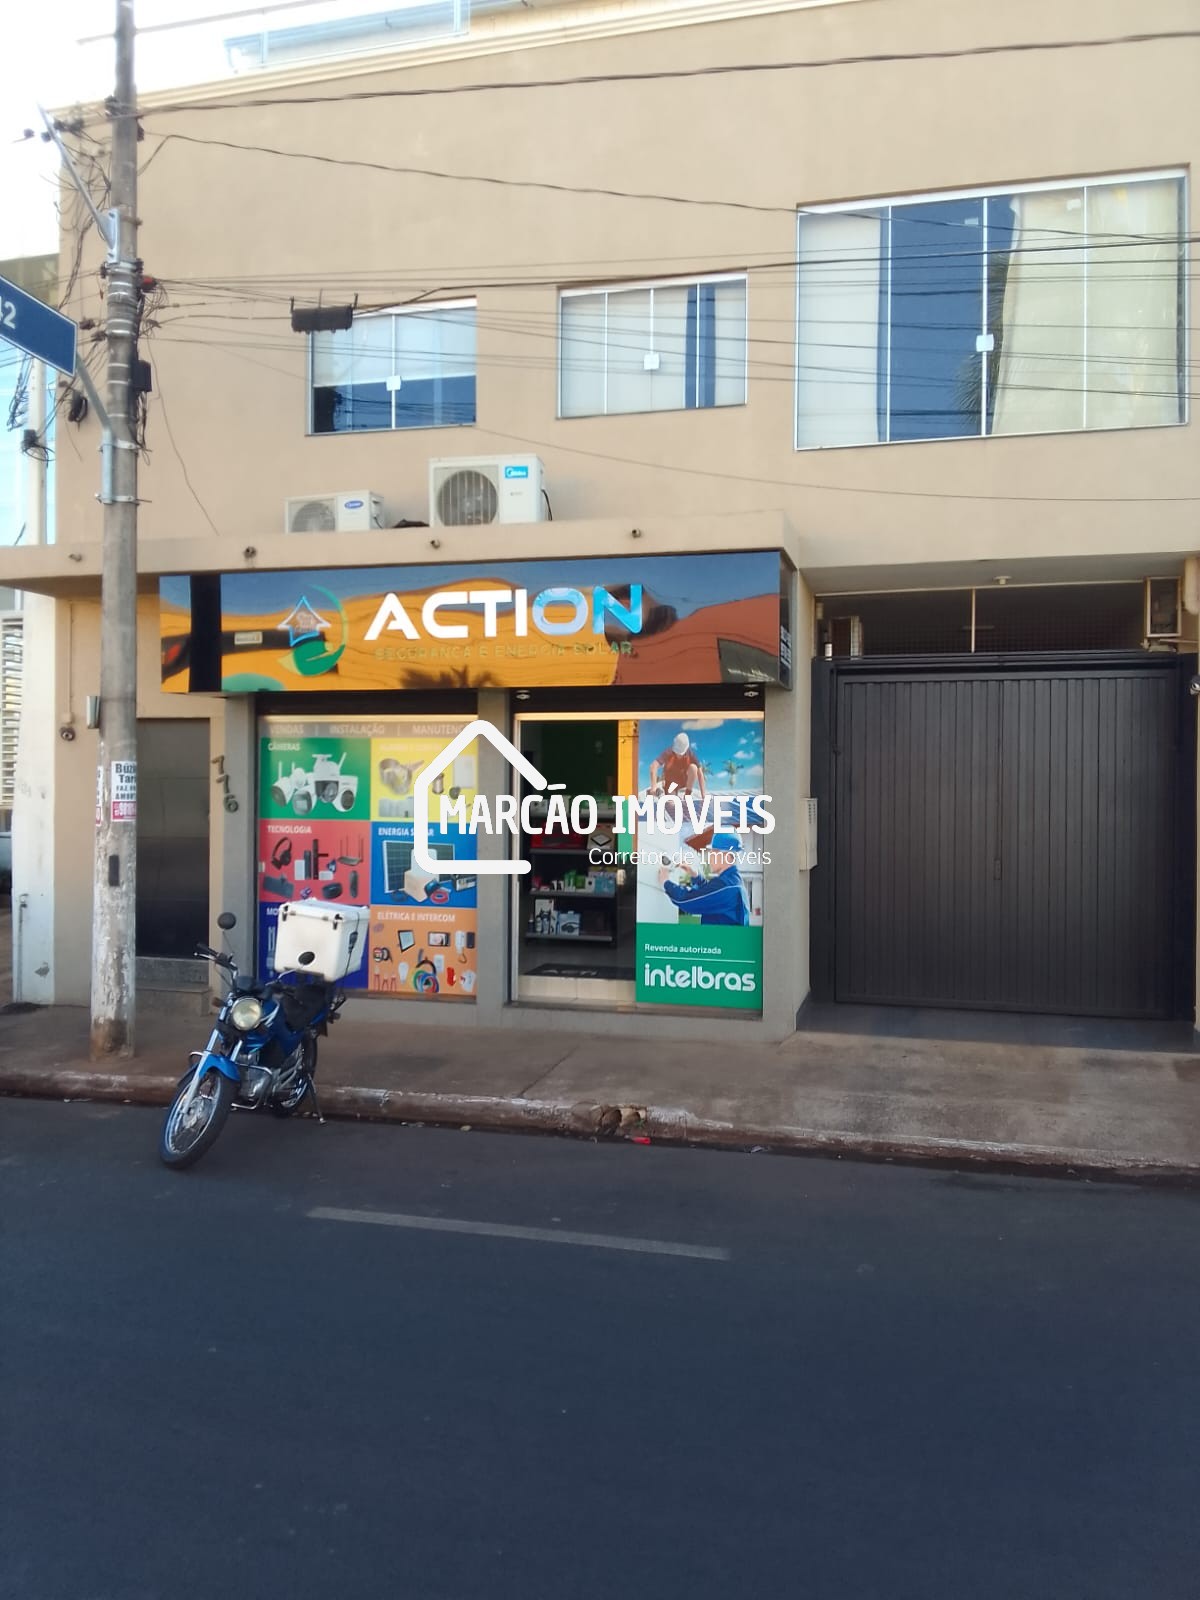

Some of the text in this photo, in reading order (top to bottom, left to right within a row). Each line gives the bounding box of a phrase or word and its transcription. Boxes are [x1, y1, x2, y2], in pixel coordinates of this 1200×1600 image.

[0, 296, 17, 329] 2
[364, 582, 643, 641] ACTION
[479, 645, 488, 657] E
[495, 643, 566, 658] ENERGIA
[574, 640, 633, 656] SOLAR
[269, 724, 304, 735] VENDAS
[329, 722, 385, 737] INSTALAÇÃO
[267, 824, 312, 835] TECNOLOGIA
[378, 826, 409, 836] ENERGIA
[417, 912, 456, 923] INTERCOM
[644, 943, 722, 955] Revenda autorizada
[644, 963, 756, 993] intelbras
